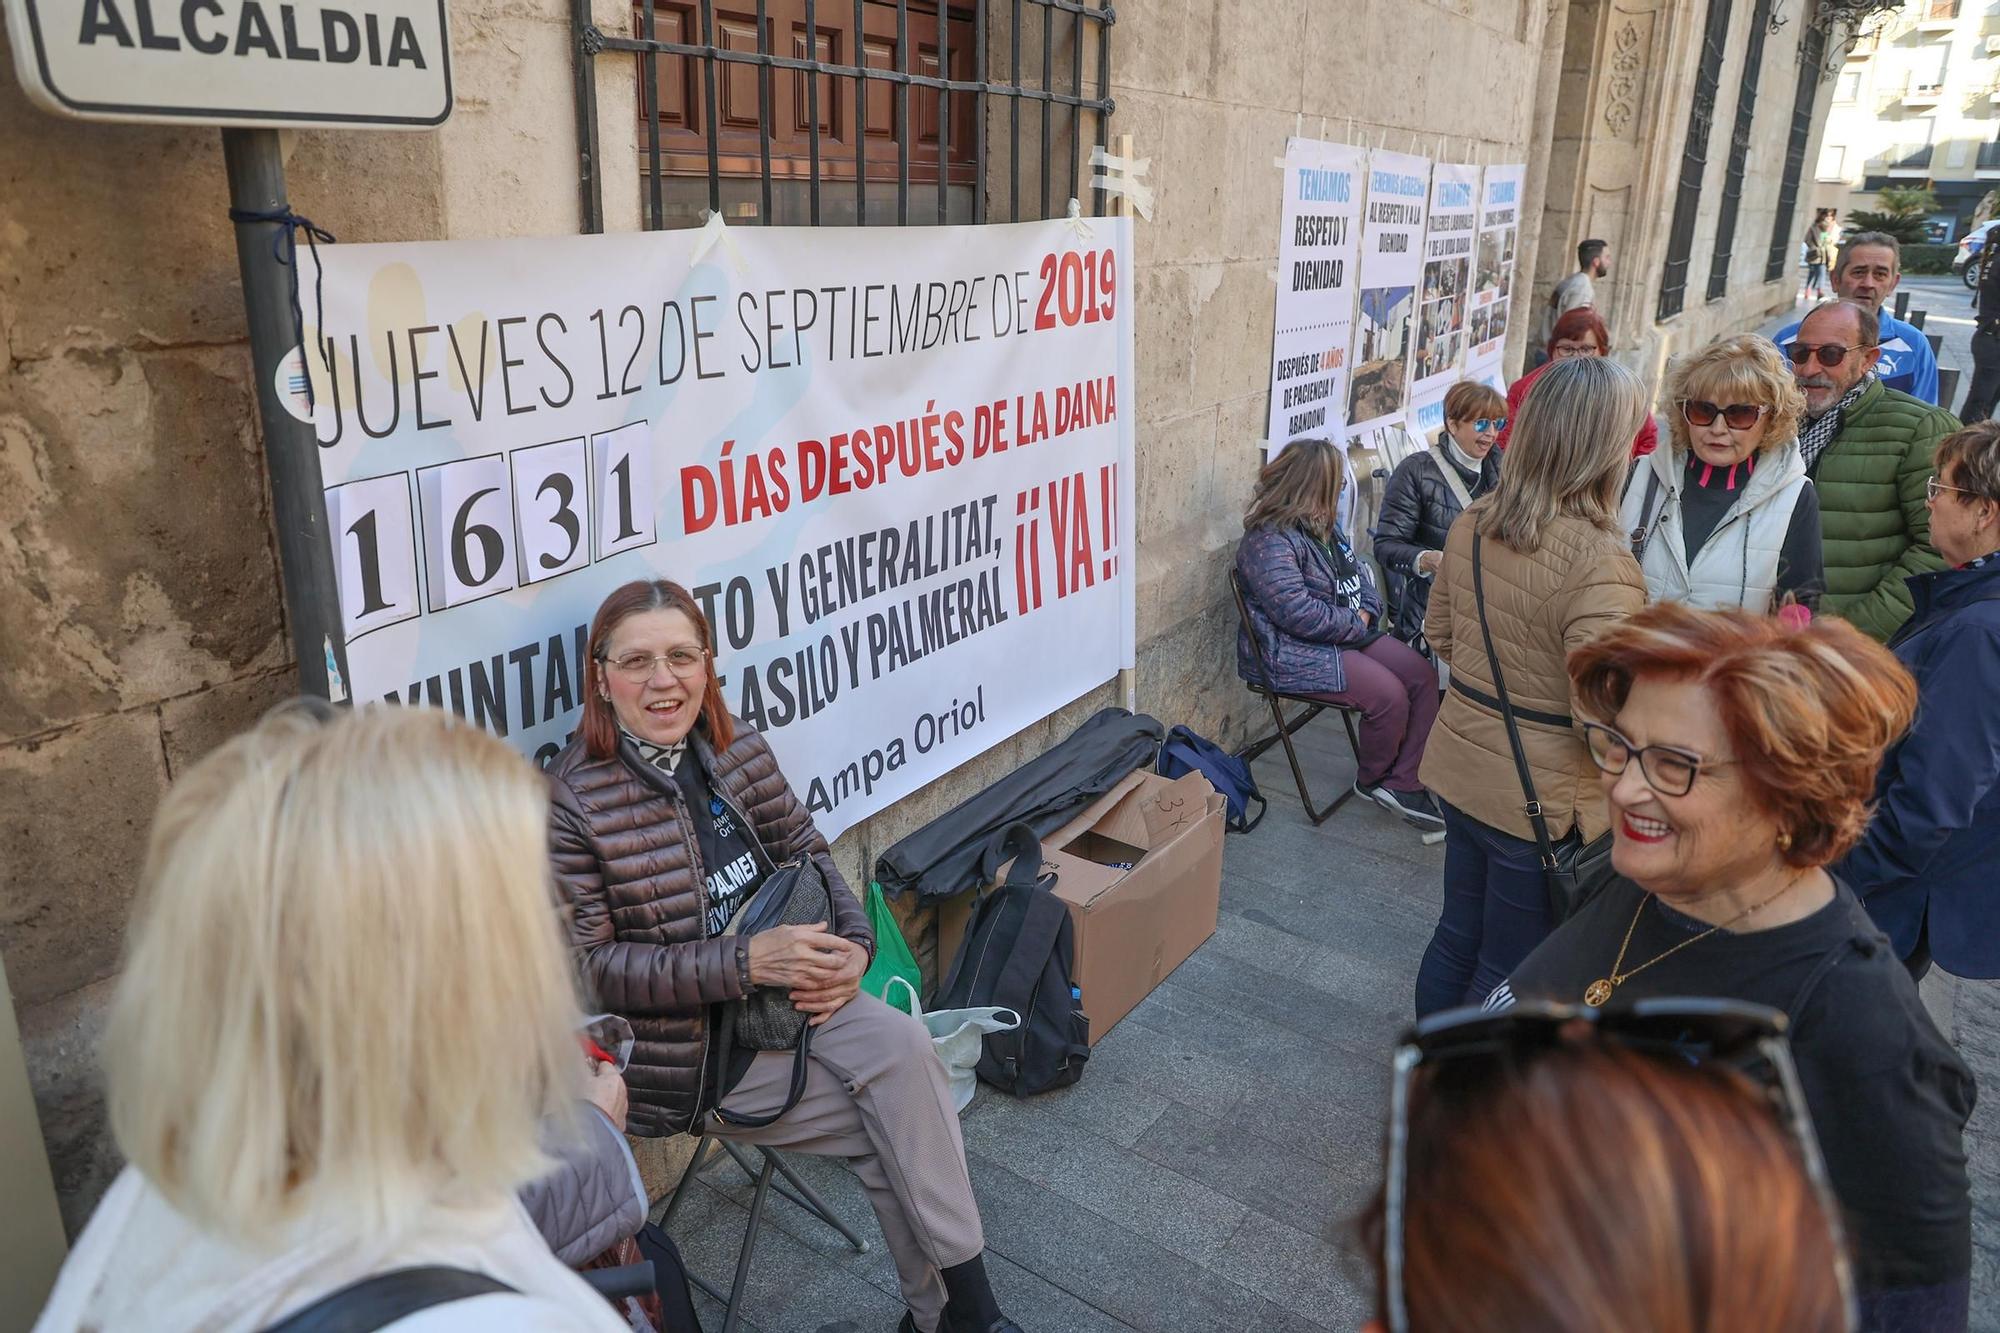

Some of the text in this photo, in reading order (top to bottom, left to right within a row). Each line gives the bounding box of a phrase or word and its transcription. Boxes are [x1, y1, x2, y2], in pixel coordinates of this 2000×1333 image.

[78, 0, 427, 70] ALCALDIA
[1298, 164, 1351, 203] TENÍAMOS
[1294, 215, 1348, 246] RESPETO Y
[1369, 202, 1377, 222] AL
[1378, 202, 1404, 224] RESPETO
[1379, 232, 1408, 253] DIGNIDAD
[1292, 259, 1343, 292] DIGNIDAD
[316, 247, 1118, 448] JUEVES 12 DE SEPTIEMBRE DE 2019
[1277, 346, 1344, 381] DESPUÉS DE 4 AÑOS
[1283, 377, 1335, 409] DE PACIENCIA Y
[1288, 406, 1325, 437] ABANDONO
[680, 439, 791, 536] DÍAS
[796, 399, 965, 504] DESPUÉS
[972, 398, 1009, 460] DE
[1016, 390, 1050, 448] LA
[1054, 375, 1118, 437] DANA
[766, 561, 790, 639] Y
[798, 493, 1002, 626] GENERALITAT,
[740, 565, 1009, 734] ASILO Y PALMERAL
[806, 684, 986, 815] Ampa Oriol
